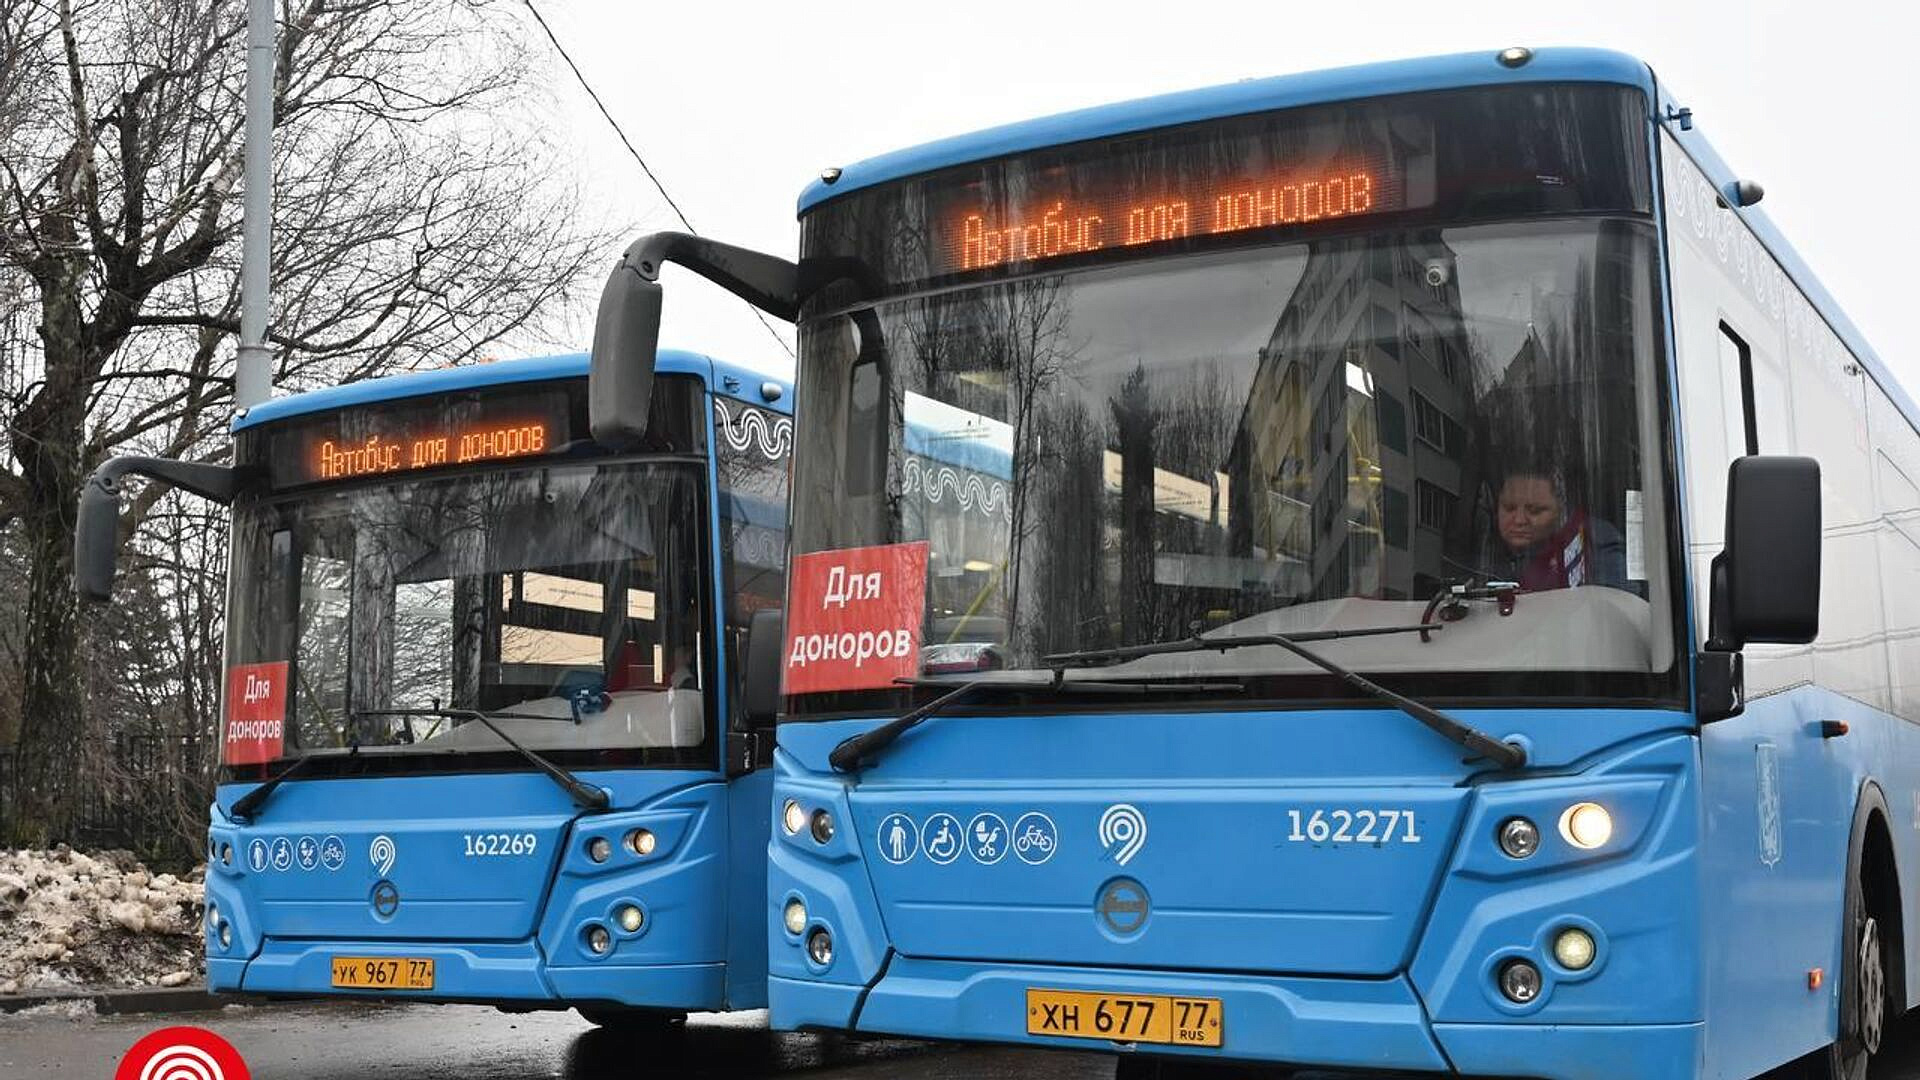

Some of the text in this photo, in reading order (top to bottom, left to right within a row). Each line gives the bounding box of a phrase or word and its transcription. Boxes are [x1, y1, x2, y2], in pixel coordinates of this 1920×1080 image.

[963, 173, 1371, 269] Автобус для доноров
[321, 425, 544, 479] Автобус для доноров
[823, 565, 881, 610] Для
[789, 629, 911, 668] доноров
[244, 674, 270, 705] Для
[227, 720, 282, 745] доноров
[1288, 809, 1421, 843] 162271
[464, 834, 537, 856] 162269
[365, 961, 398, 985] 967
[409, 961, 427, 979] 77
[1095, 1000, 1155, 1036] 677
[1175, 1001, 1209, 1029] 77
[1178, 1030, 1205, 1041] RUS
